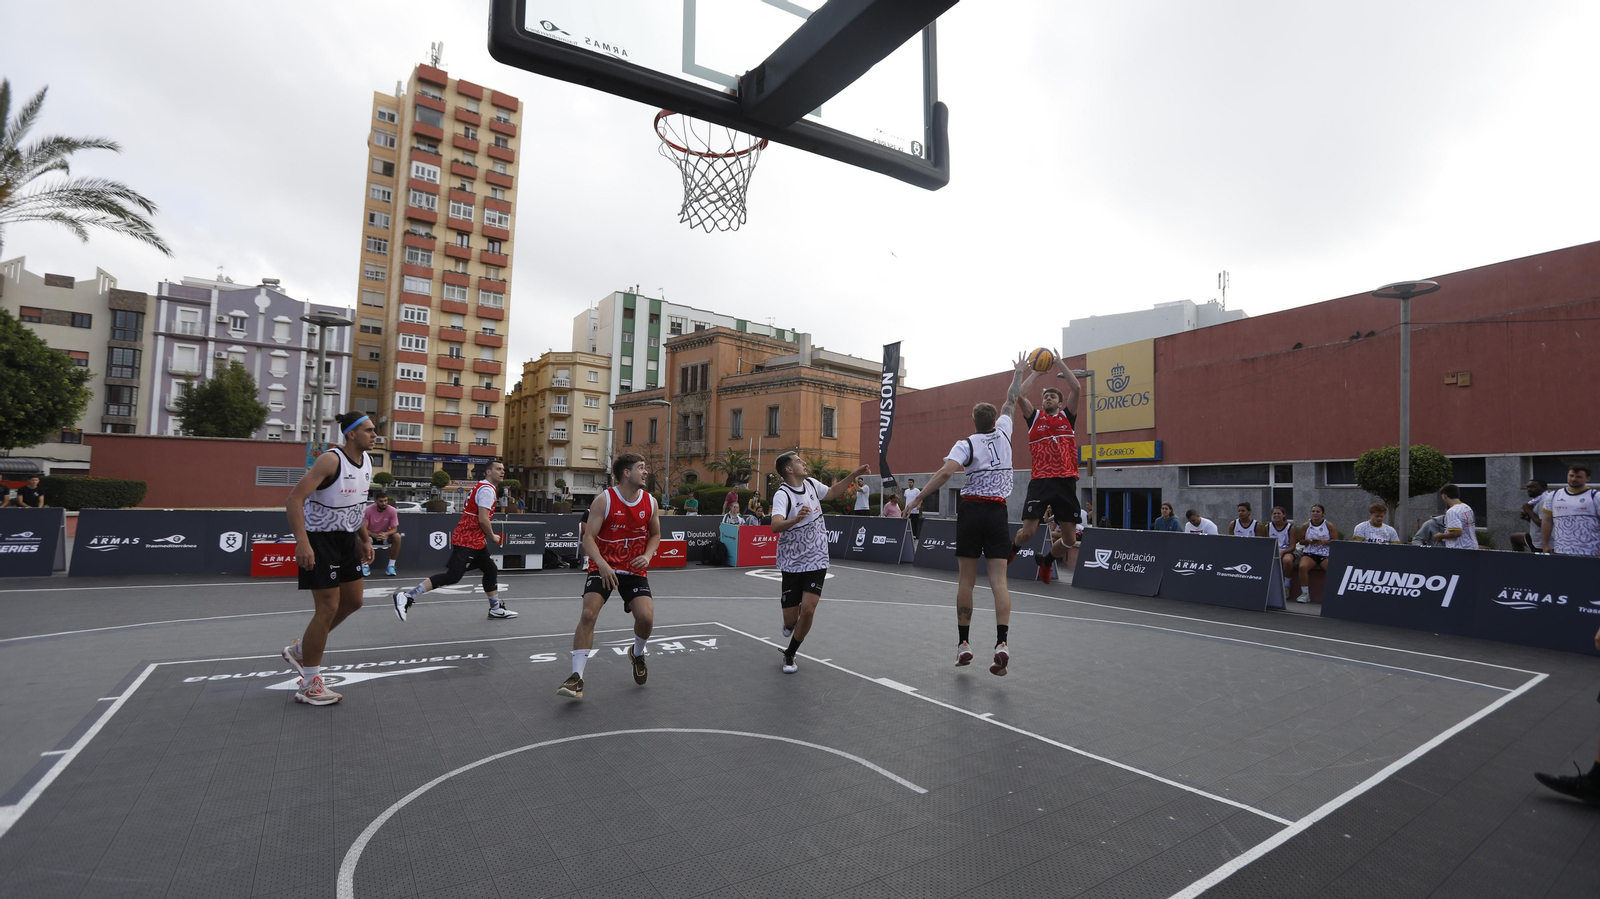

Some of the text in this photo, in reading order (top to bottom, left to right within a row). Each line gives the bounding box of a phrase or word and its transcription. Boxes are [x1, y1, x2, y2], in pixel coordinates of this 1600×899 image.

[987, 441, 1001, 468] 1
[1106, 447, 1135, 456] CORREOS
[89, 537, 141, 545] ARMAS
[1113, 550, 1156, 562] Diputación
[1111, 562, 1146, 573] de Cádiz
[1174, 561, 1213, 571] ARMAS
[1215, 571, 1263, 580] Trasmediterránea
[1350, 568, 1447, 592] MUNDO
[1347, 582, 1422, 598] DEPORTIVO
[1497, 590, 1569, 604] ARMAS
[1577, 606, 1600, 614] Tras
